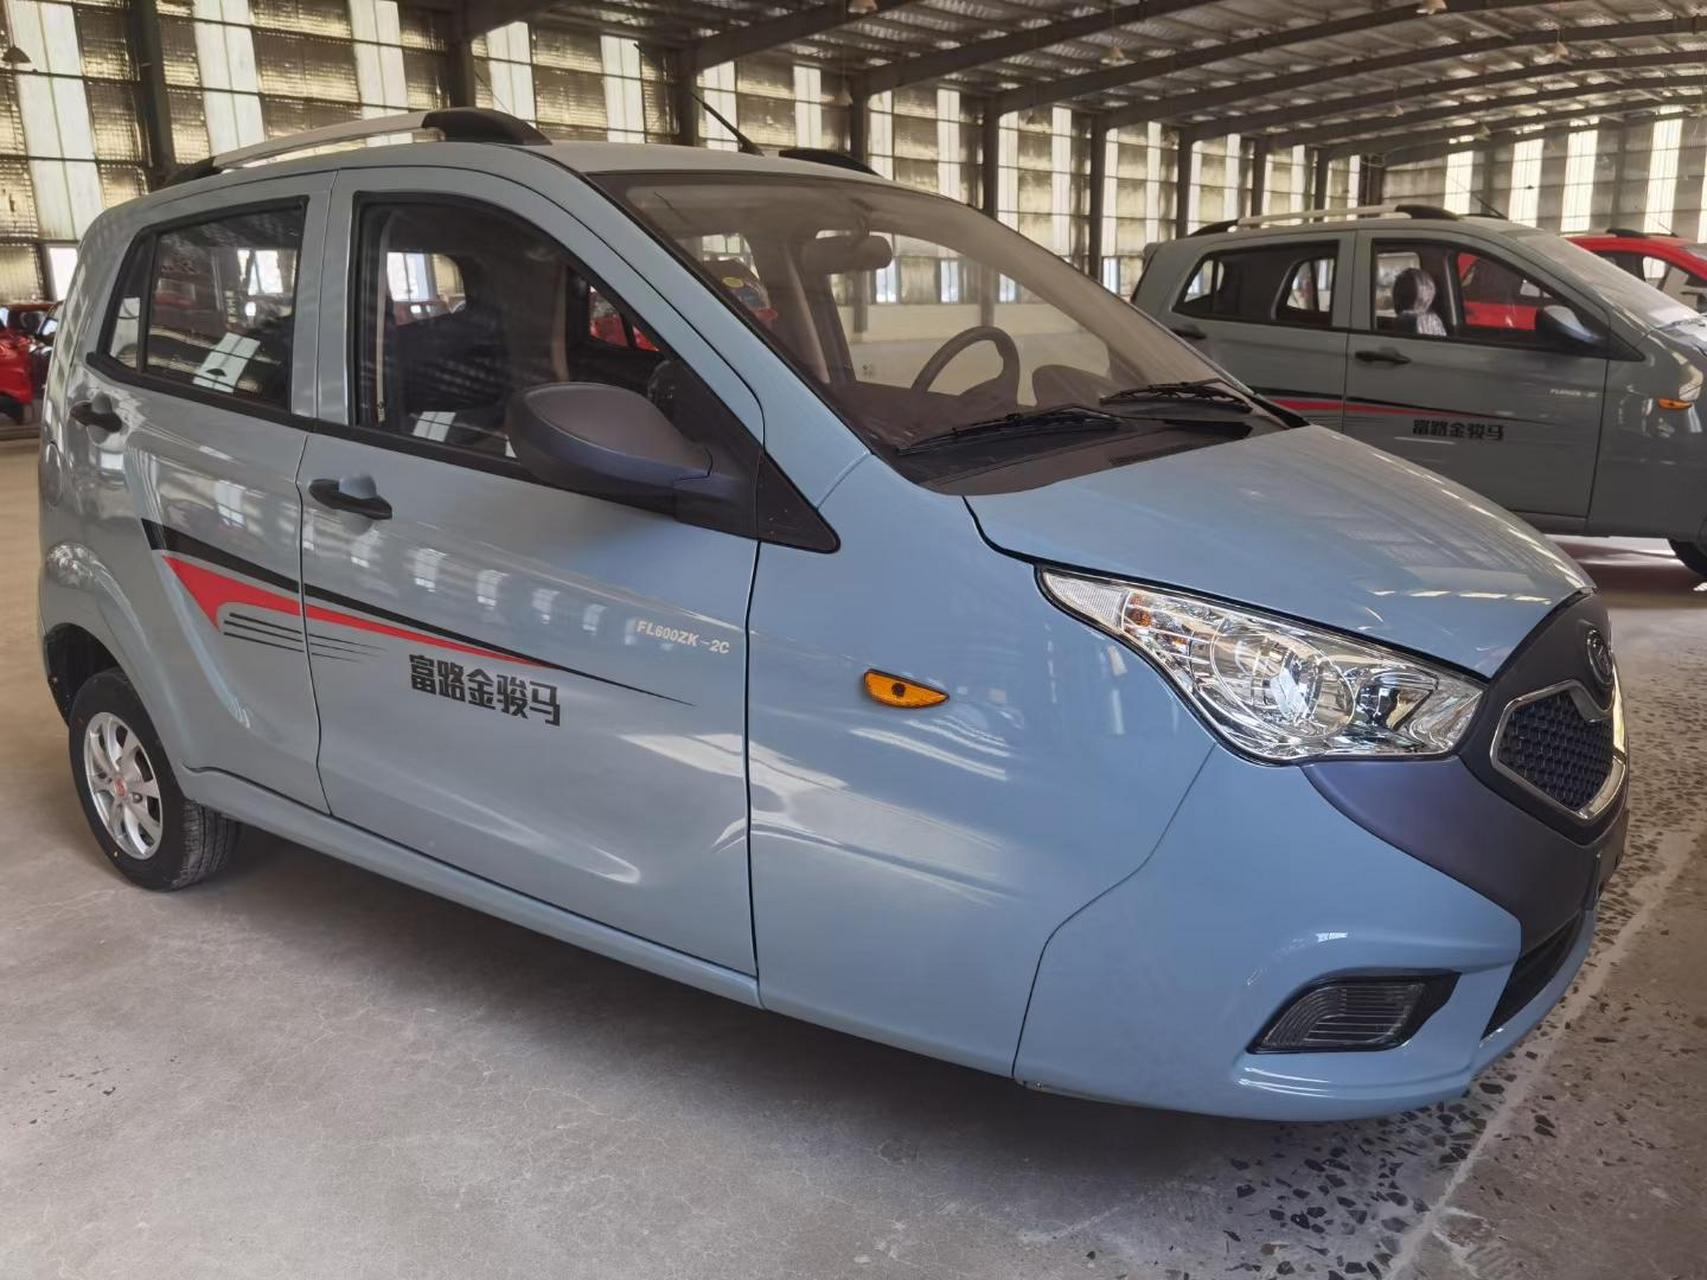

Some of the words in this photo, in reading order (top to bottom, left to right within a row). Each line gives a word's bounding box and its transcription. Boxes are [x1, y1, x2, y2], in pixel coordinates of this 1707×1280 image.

[409, 654, 560, 726] 富路金骏马
